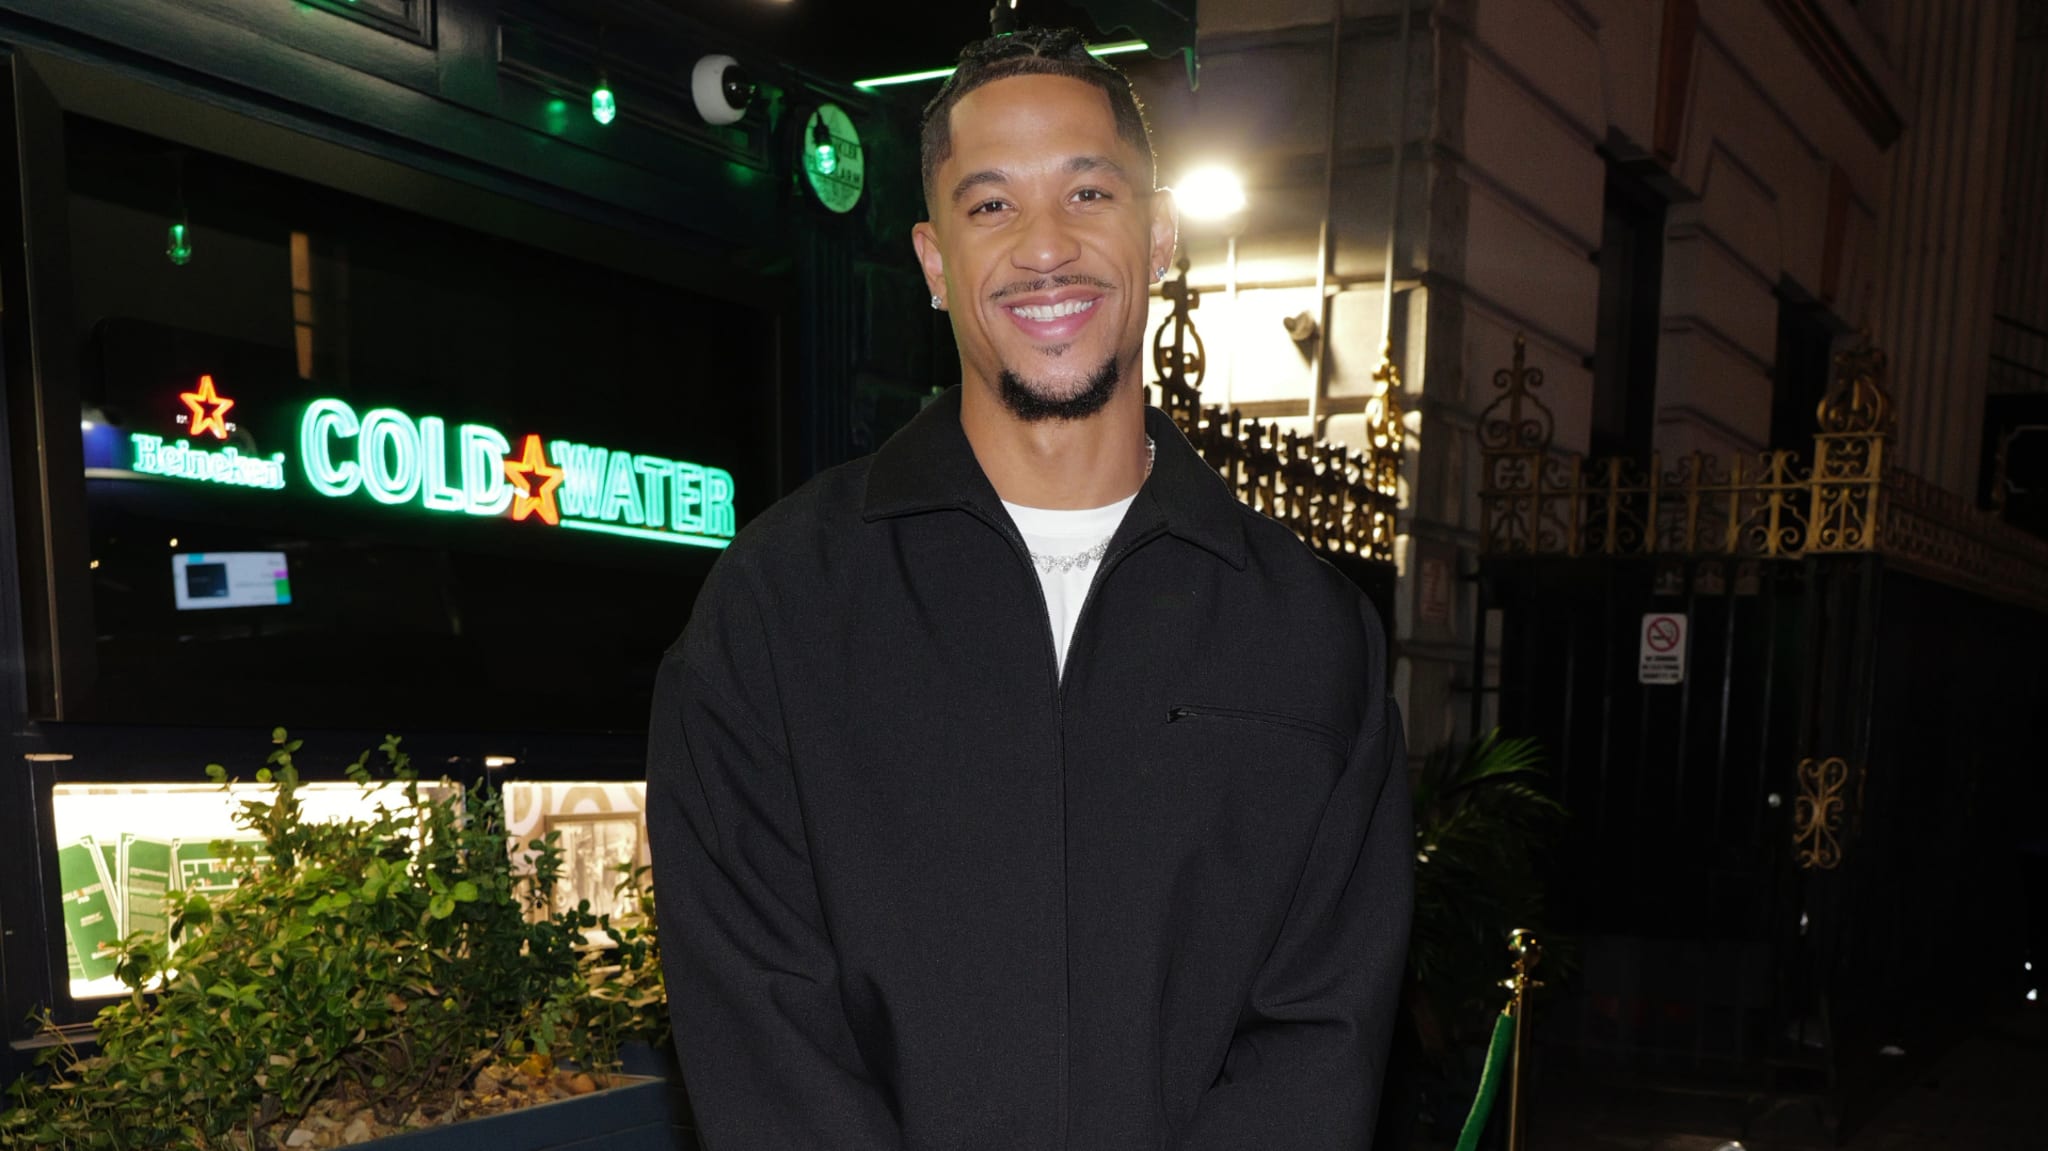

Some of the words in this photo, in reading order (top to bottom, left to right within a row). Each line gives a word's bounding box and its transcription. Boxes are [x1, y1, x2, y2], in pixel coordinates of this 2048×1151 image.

[131, 432, 285, 490] Heineken
[300, 398, 513, 515] COLD
[550, 440, 735, 537] WATER
